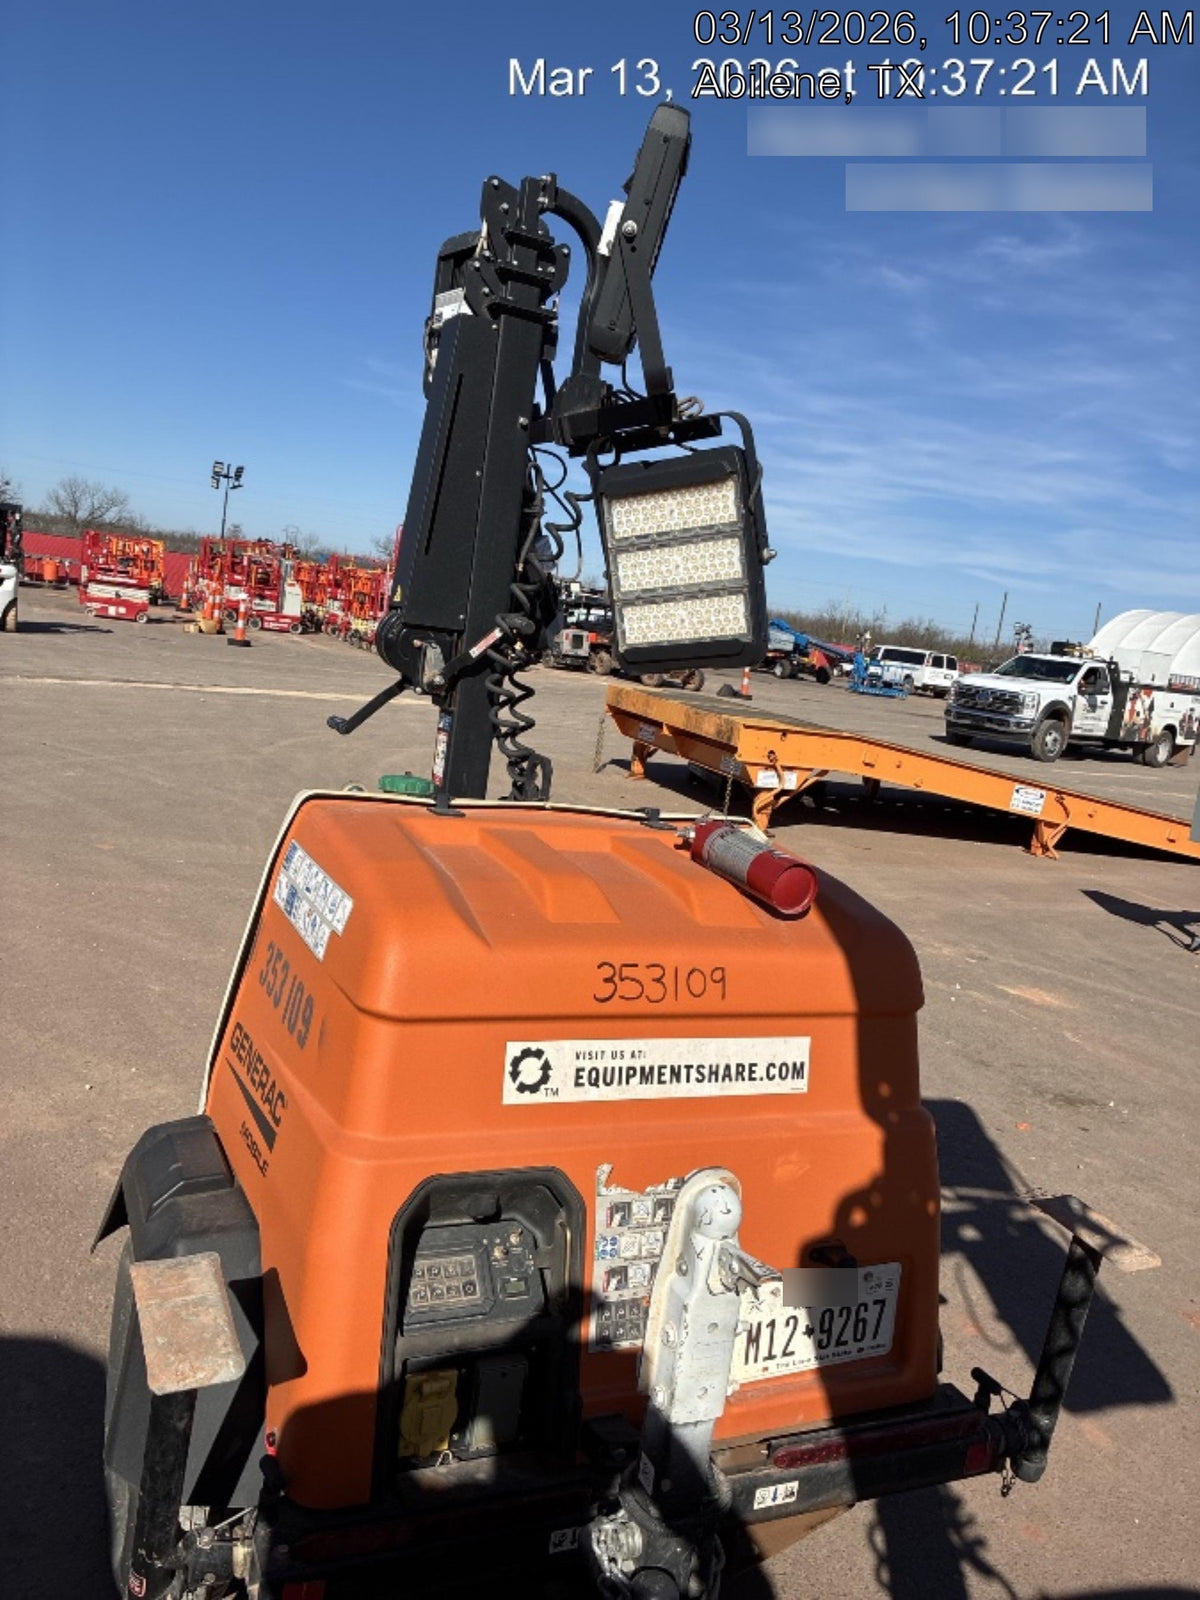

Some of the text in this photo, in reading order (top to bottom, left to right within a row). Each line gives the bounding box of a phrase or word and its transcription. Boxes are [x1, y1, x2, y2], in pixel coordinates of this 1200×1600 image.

[258, 940, 315, 1049] 353109
[593, 961, 726, 1003] 353109
[230, 1022, 286, 1128] GENERAC
[573, 1060, 806, 1088] EQUIPMENTSHARE.COM
[575, 1050, 605, 1061] VISIT
[610, 1049, 625, 1060] US
